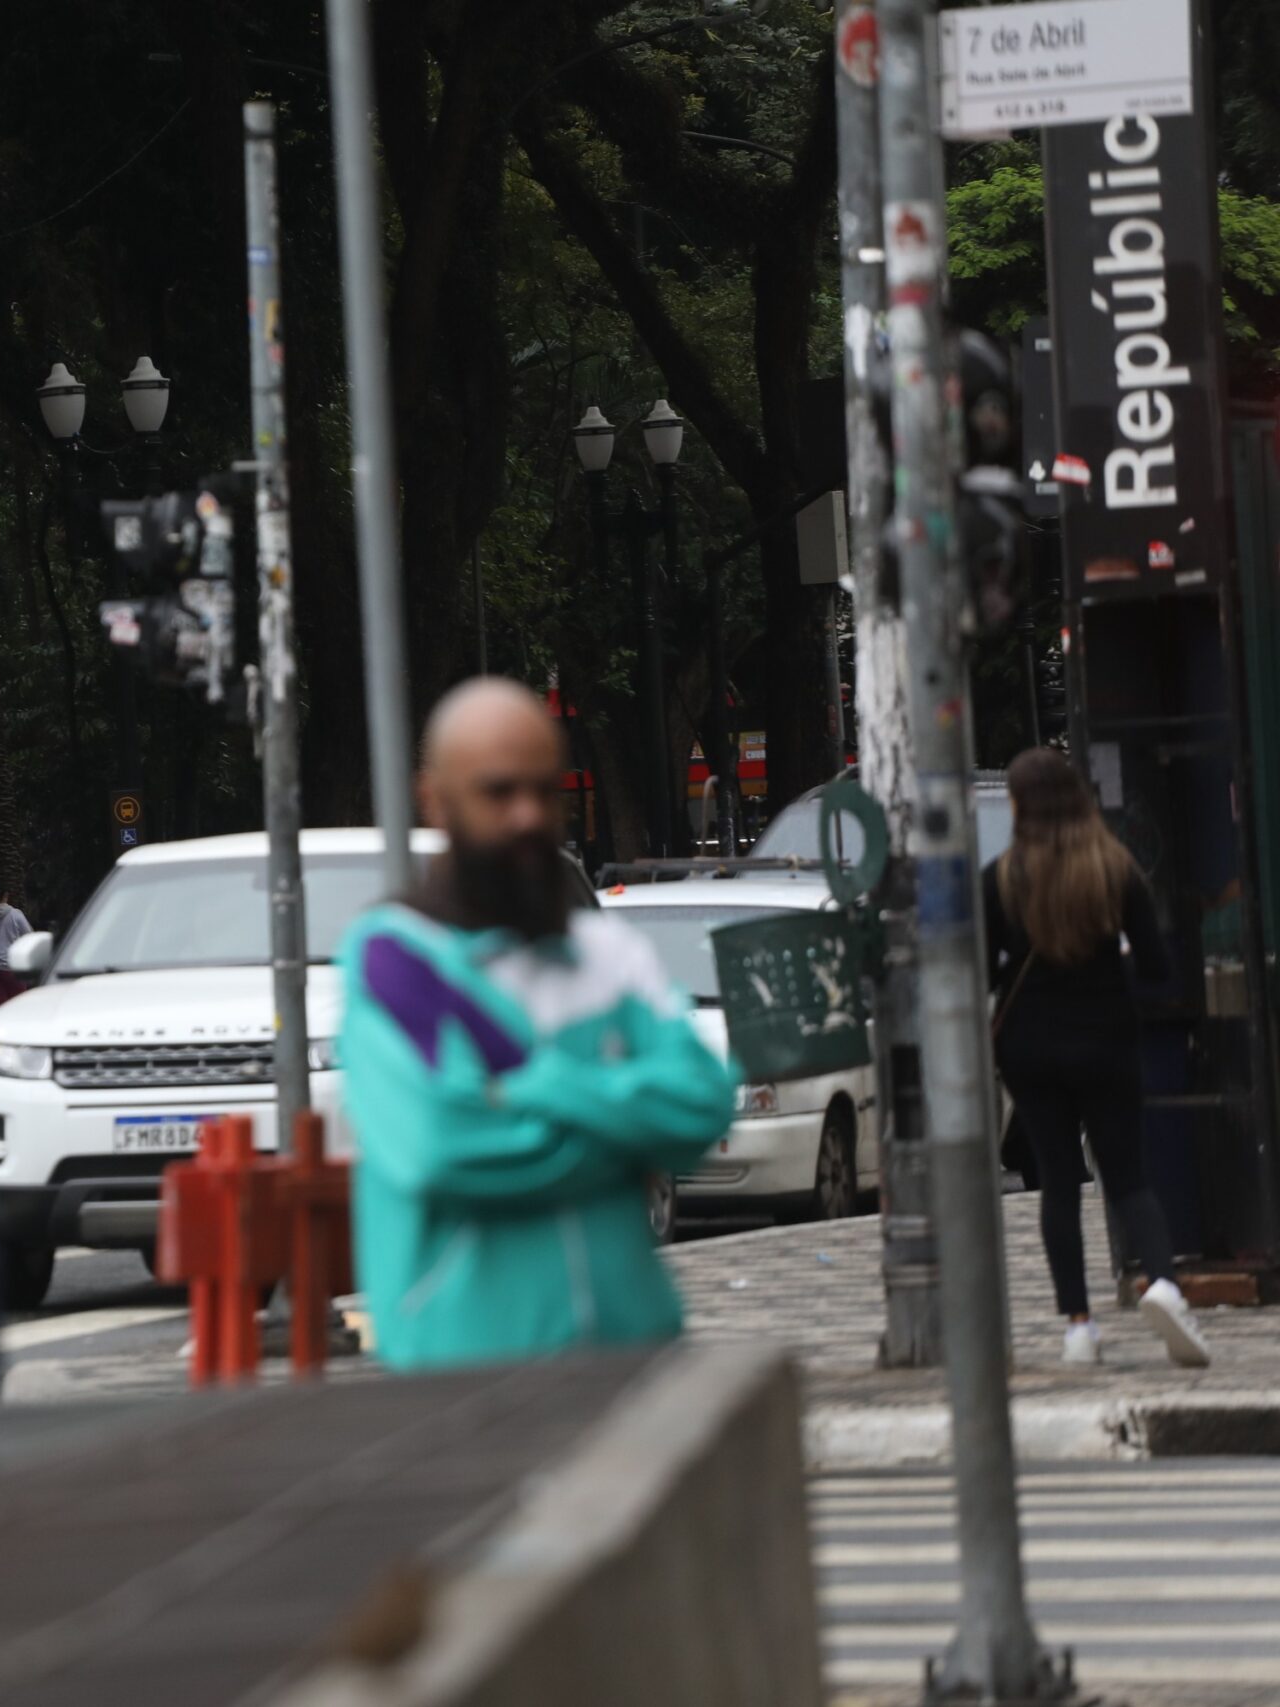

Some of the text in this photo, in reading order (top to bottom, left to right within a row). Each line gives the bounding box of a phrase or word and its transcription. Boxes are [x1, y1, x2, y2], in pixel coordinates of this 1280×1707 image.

[968, 18, 1086, 56] 7 de Abril
[1087, 113, 1191, 510] Repúblic
[191, 1025, 275, 1036] ROVE
